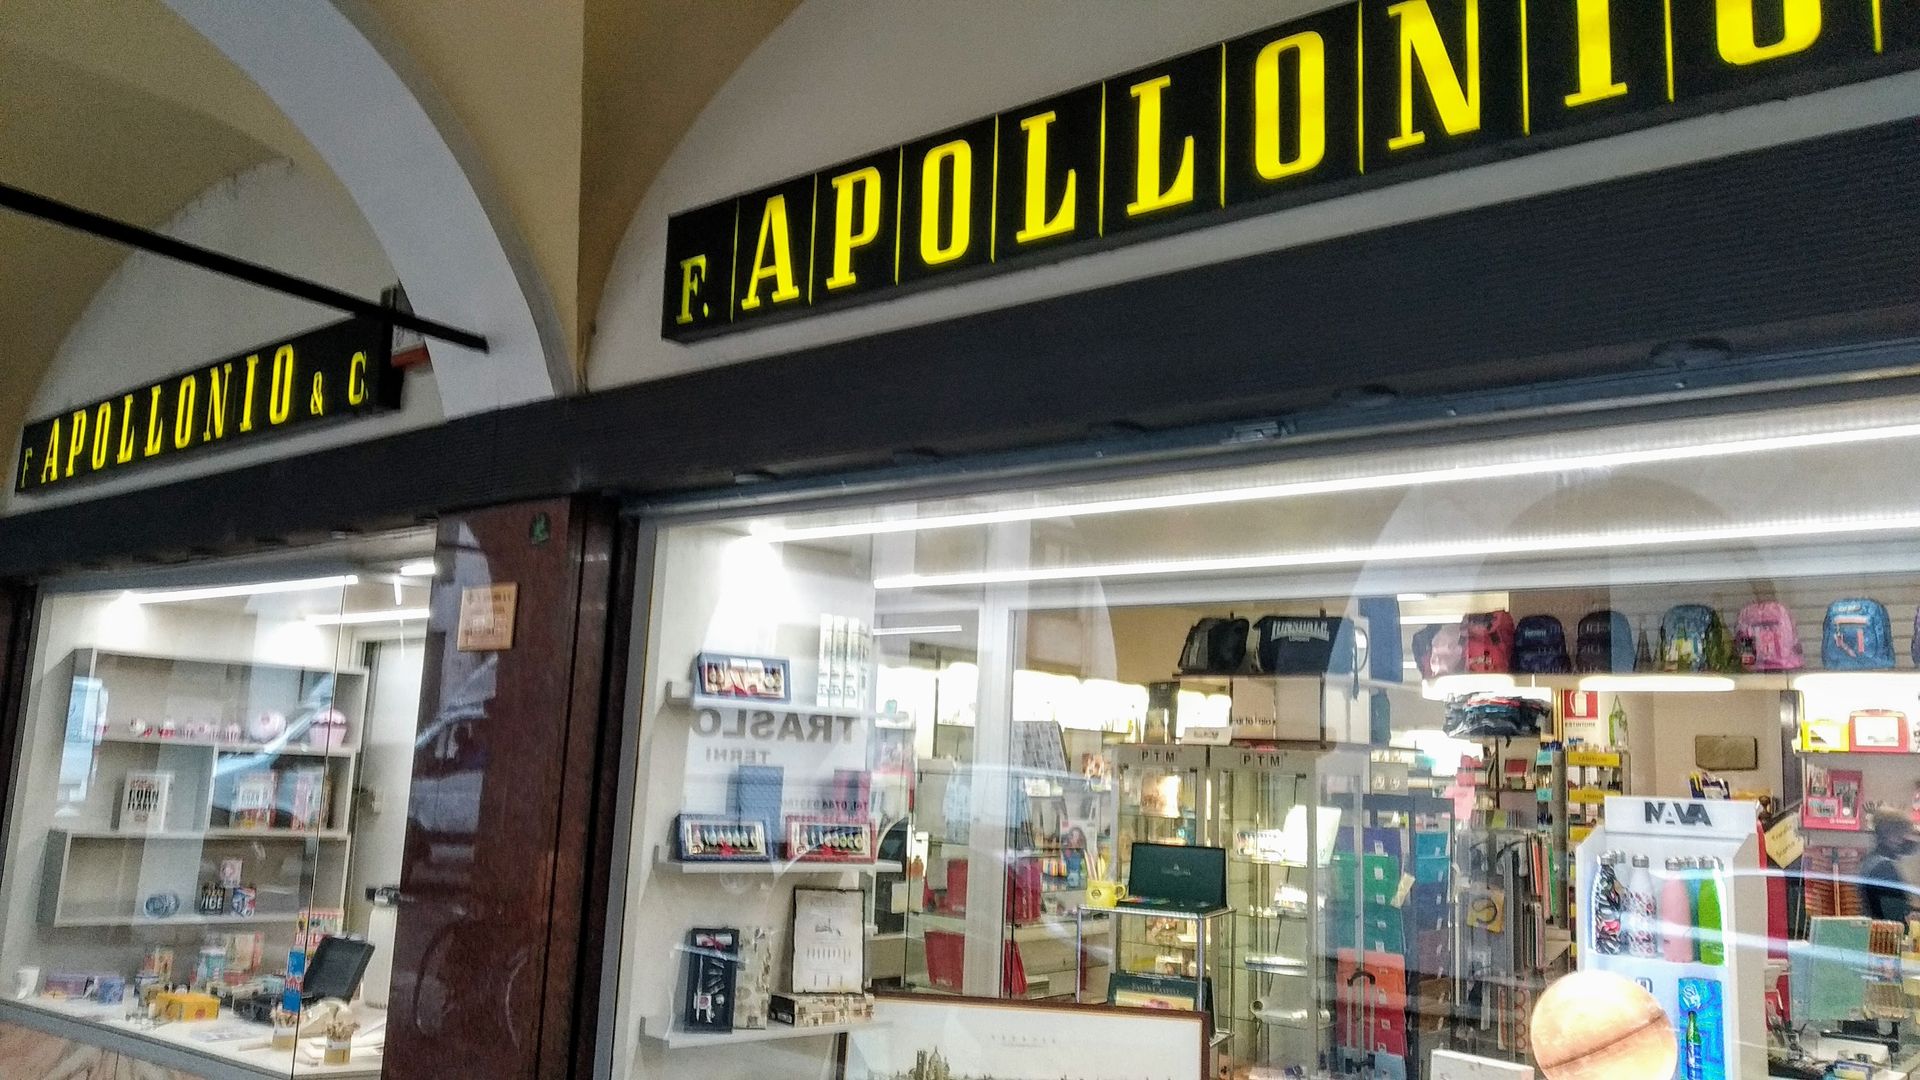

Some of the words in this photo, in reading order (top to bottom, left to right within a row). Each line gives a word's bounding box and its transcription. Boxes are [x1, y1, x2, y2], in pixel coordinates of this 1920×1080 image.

[676, 253, 711, 323] F.
[40, 343, 294, 484] APOLLONIO
[310, 370, 324, 416] &
[1141, 750, 1175, 763] PTM
[1243, 754, 1280, 767] PTM
[1644, 801, 1713, 827] NAVA
